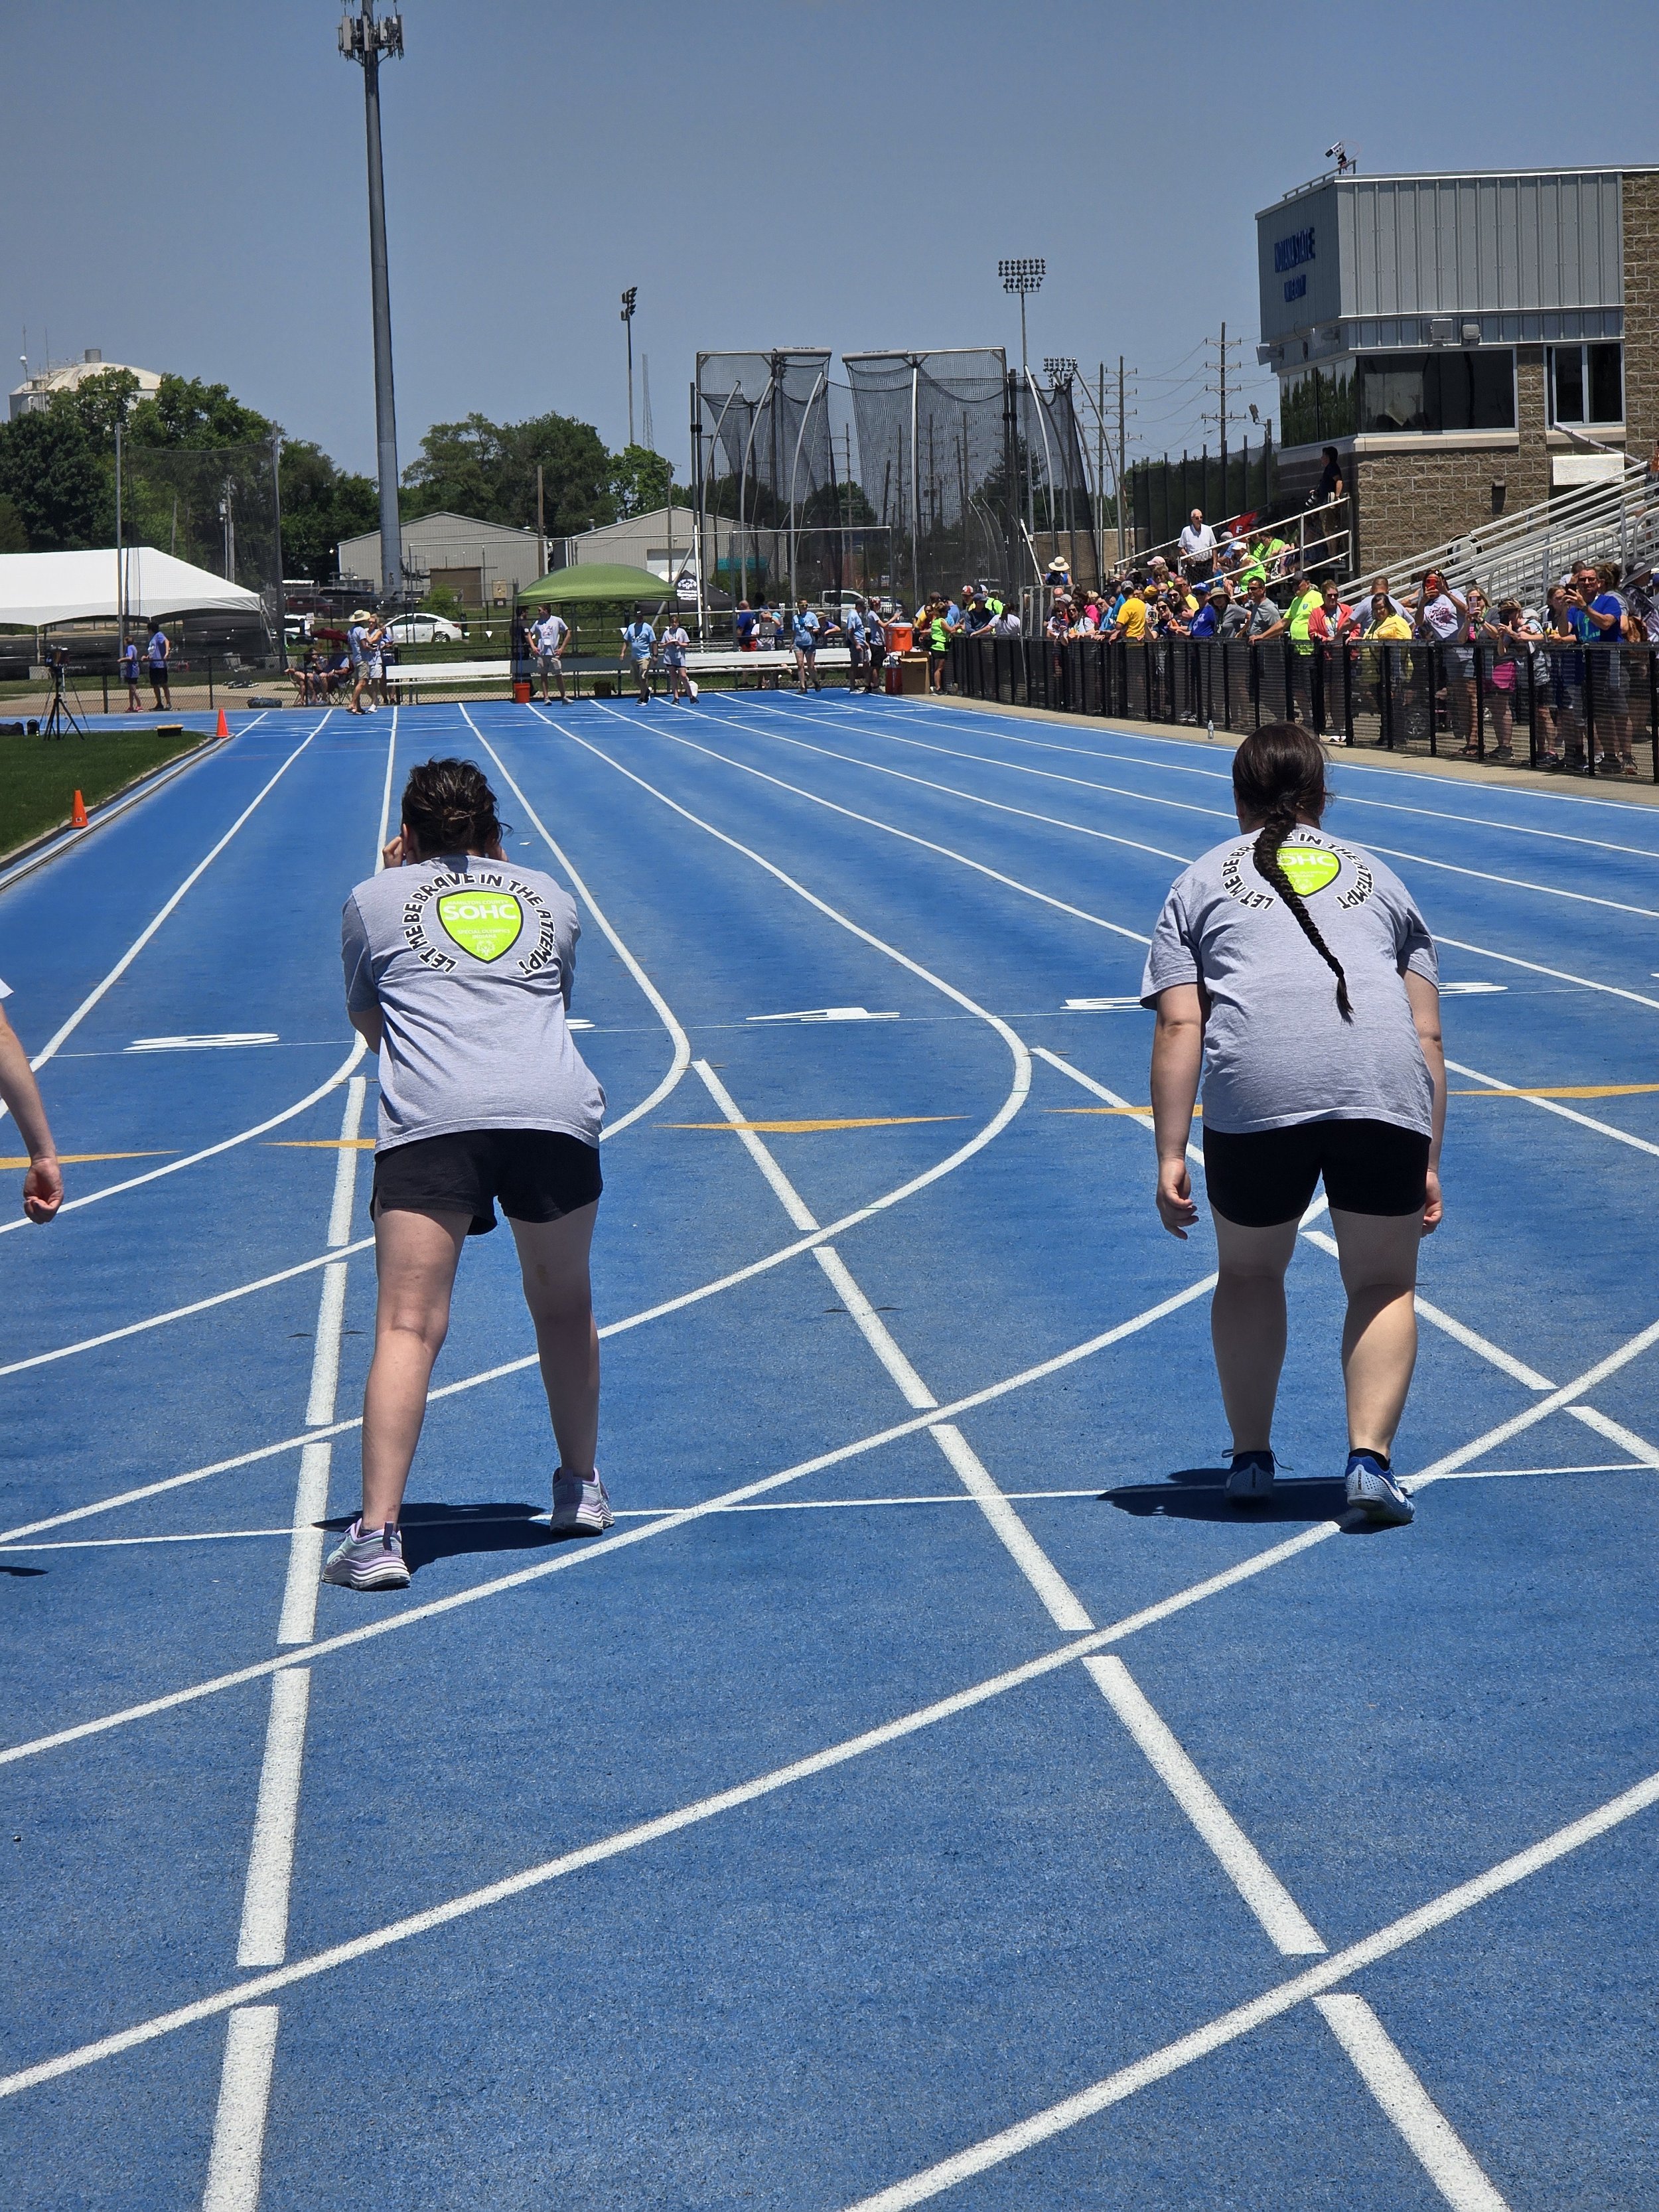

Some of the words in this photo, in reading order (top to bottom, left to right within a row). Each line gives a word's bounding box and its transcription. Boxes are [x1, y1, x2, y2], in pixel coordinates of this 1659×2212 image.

[1299, 834, 1323, 845] IN
[1277, 855, 1335, 867] OHC
[1327, 843, 1363, 863] THE
[1222, 858, 1240, 877] BE
[412, 873, 475, 903] BRAVE
[480, 873, 502, 887] IN
[1224, 874, 1246, 897] ME
[1337, 861, 1373, 910] ATTEMPT
[508, 880, 543, 907] THE
[1240, 891, 1275, 910] LET
[403, 903, 423, 923] BE
[443, 903, 518, 921] SOHC
[405, 924, 427, 950] ME
[518, 909, 554, 975] ATTEMPT
[419, 948, 457, 972] LET
[745, 1007, 901, 1021] 4
[123, 1033, 280, 1051] 2
